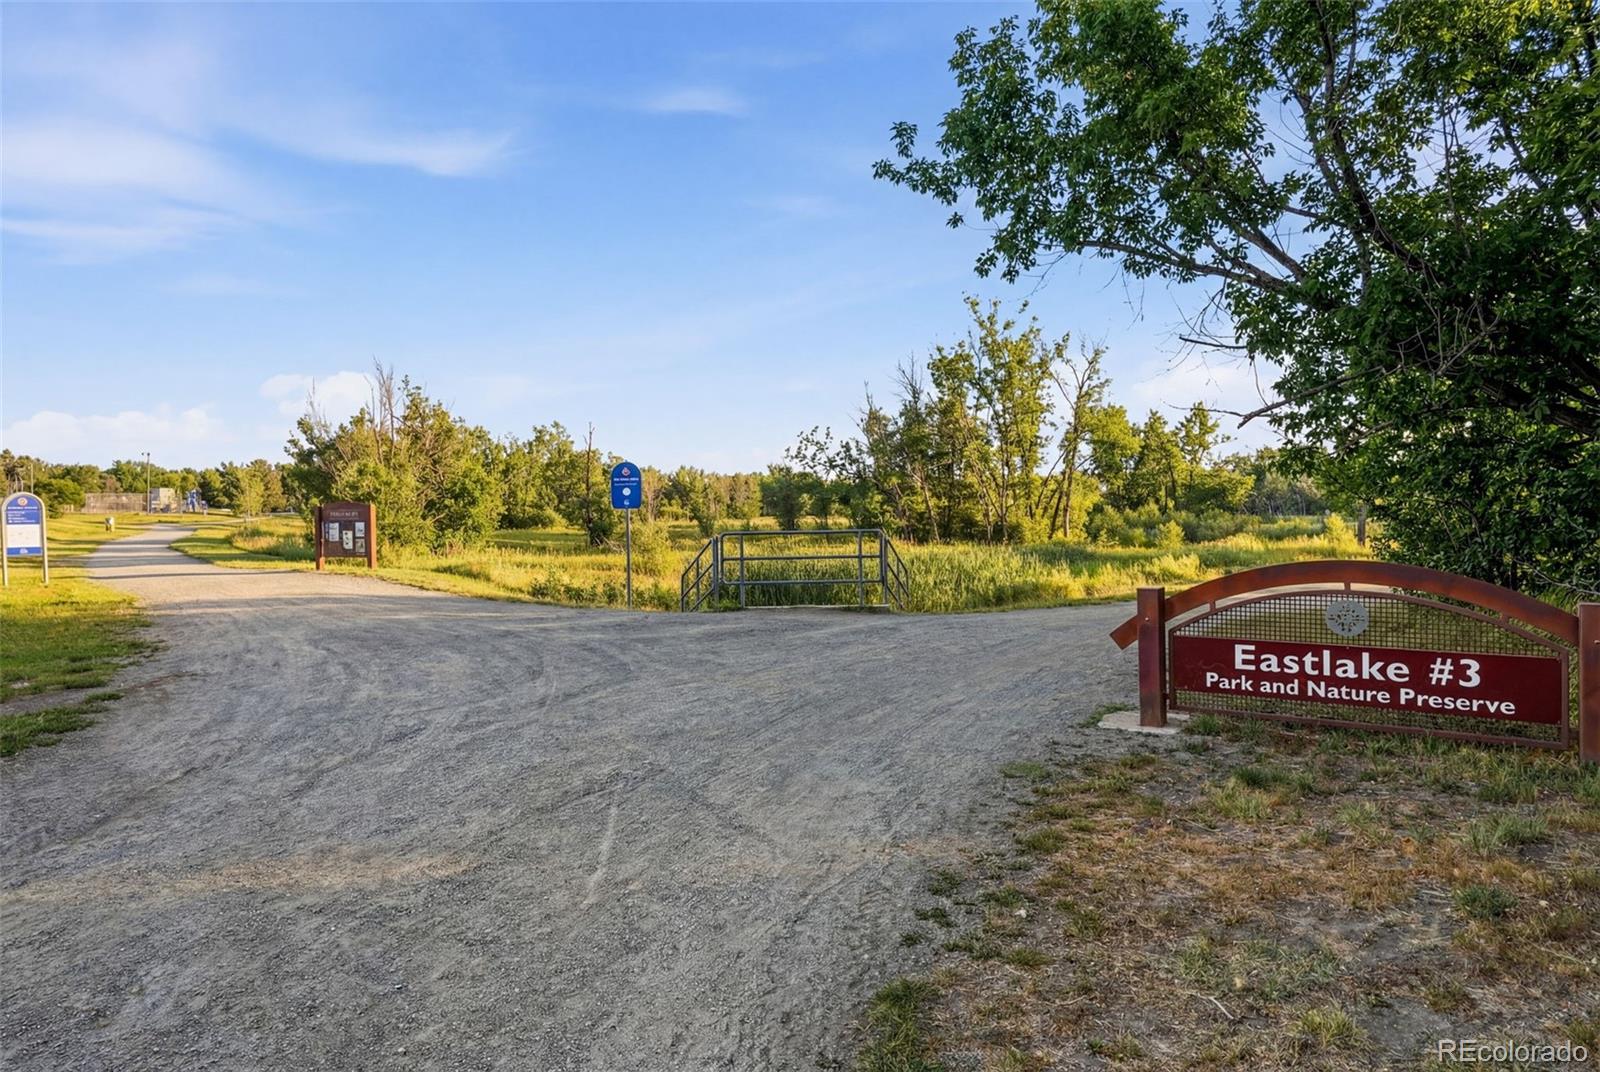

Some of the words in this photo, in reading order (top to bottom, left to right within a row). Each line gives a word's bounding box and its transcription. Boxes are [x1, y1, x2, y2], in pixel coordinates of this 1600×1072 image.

[1234, 643, 1410, 683] Eastlake
[1429, 657, 1481, 688] #3
[1206, 671, 1254, 692] Park
[1259, 678, 1299, 696] and
[1307, 680, 1391, 704] Nature
[1399, 687, 1516, 716] Preserve
